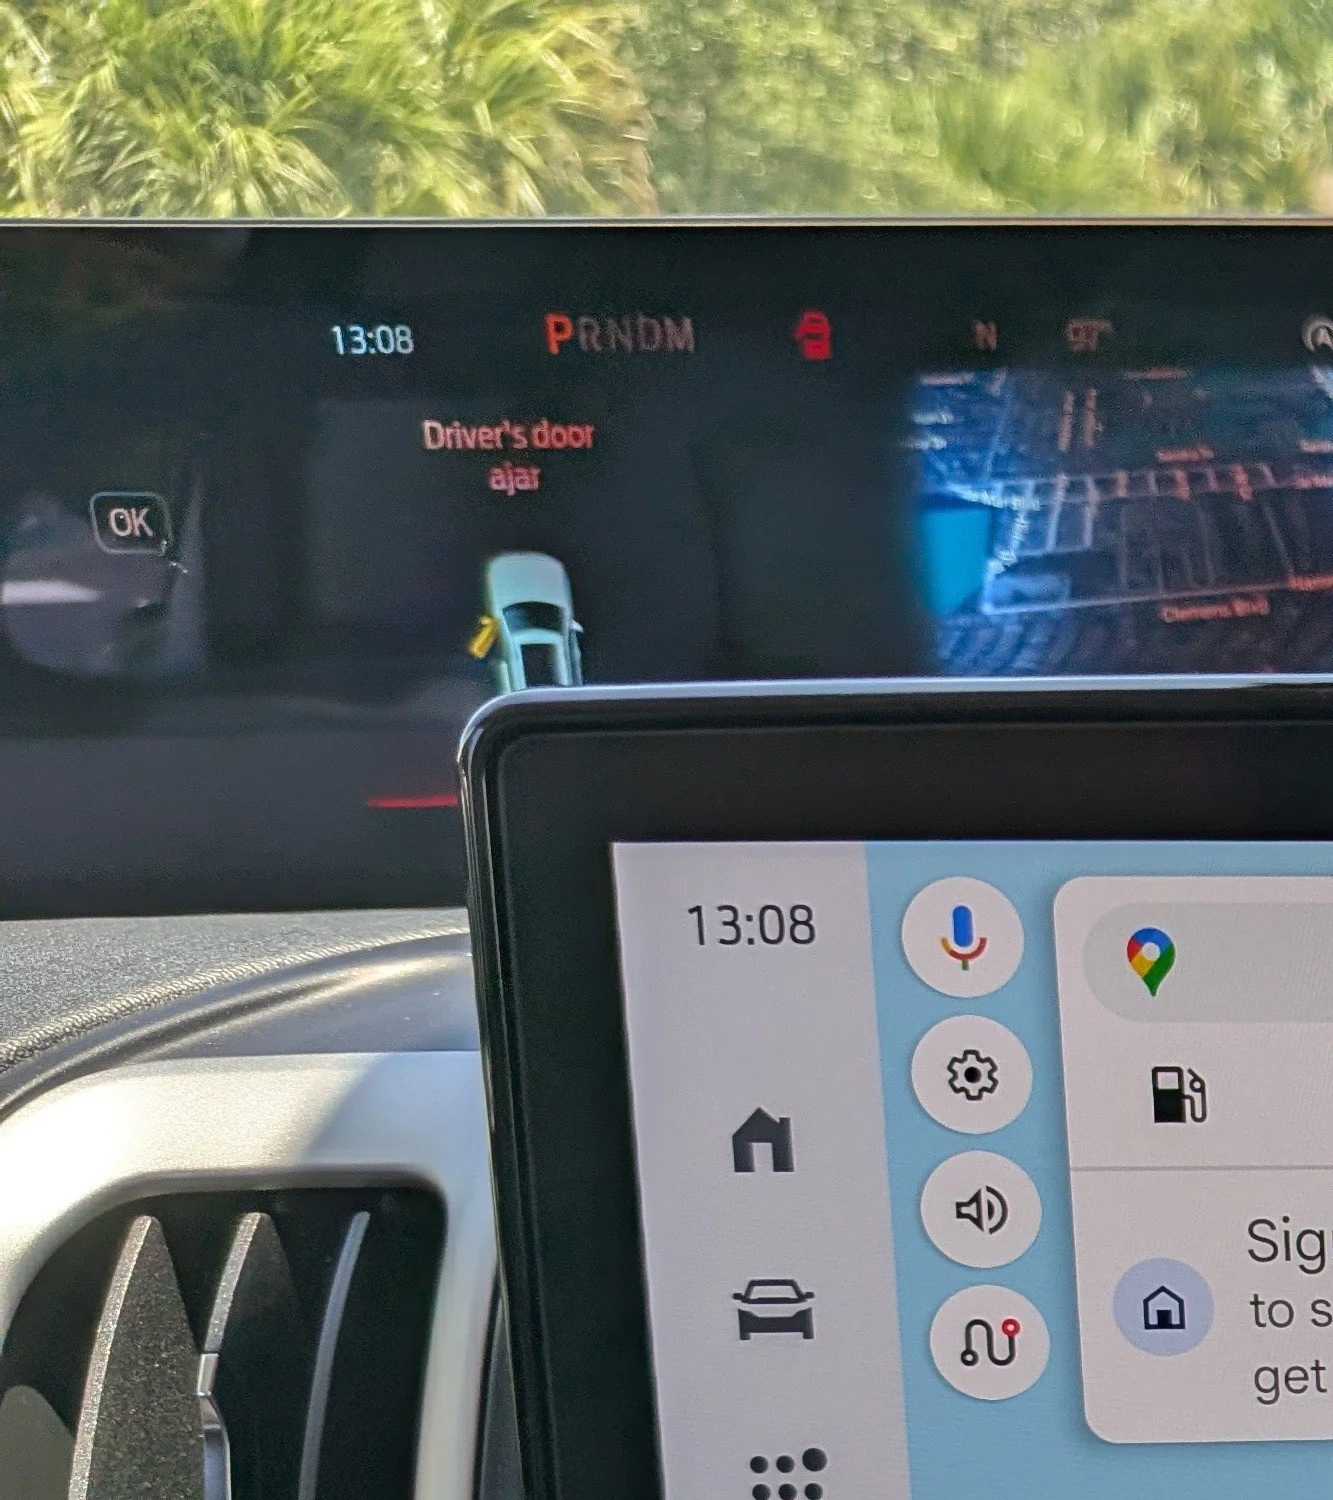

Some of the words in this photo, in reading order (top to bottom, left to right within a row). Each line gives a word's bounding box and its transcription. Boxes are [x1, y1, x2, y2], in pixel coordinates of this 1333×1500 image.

[330, 323, 415, 356] 13:08
[421, 418, 529, 452] Driver's
[531, 416, 596, 450] door
[487, 461, 542, 498] ajar
[108, 505, 154, 540] OK
[687, 903, 817, 946] 13:08
[1249, 1293, 1295, 1329] to
[1253, 1359, 1328, 1405] get
